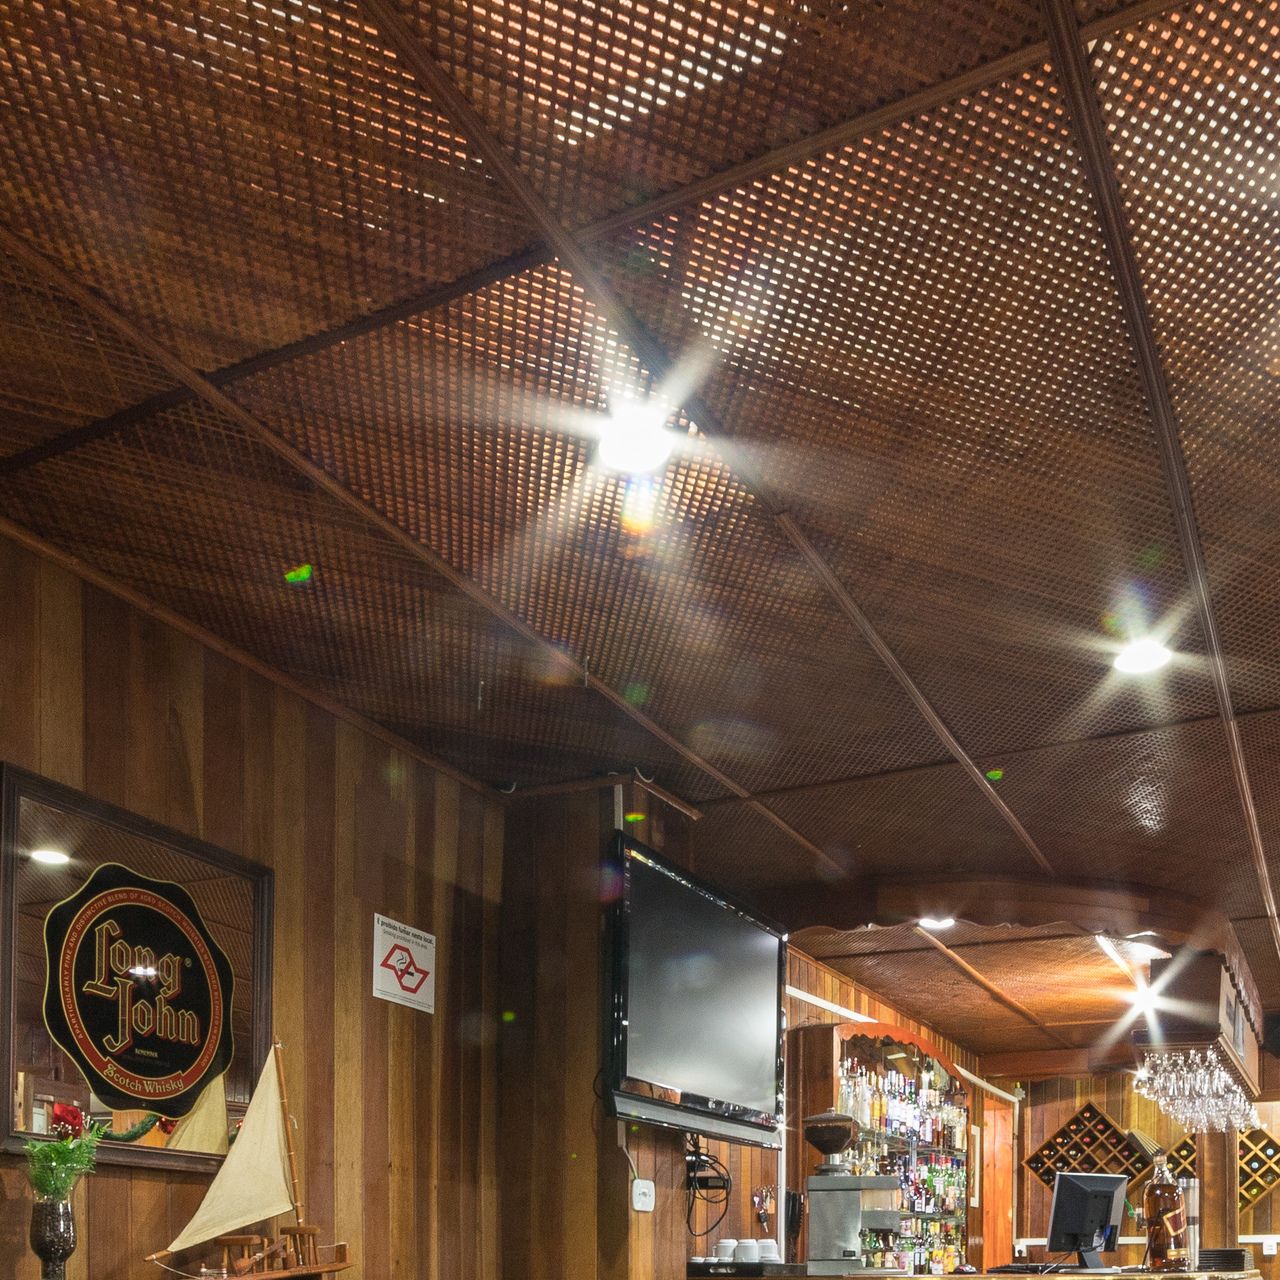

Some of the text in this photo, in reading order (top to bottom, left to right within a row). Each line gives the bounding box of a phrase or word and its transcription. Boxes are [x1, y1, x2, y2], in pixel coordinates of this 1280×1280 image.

[82, 919, 182, 999] Long
[102, 976, 201, 1055] John
[104, 1063, 184, 1094] Scotch Whisky
